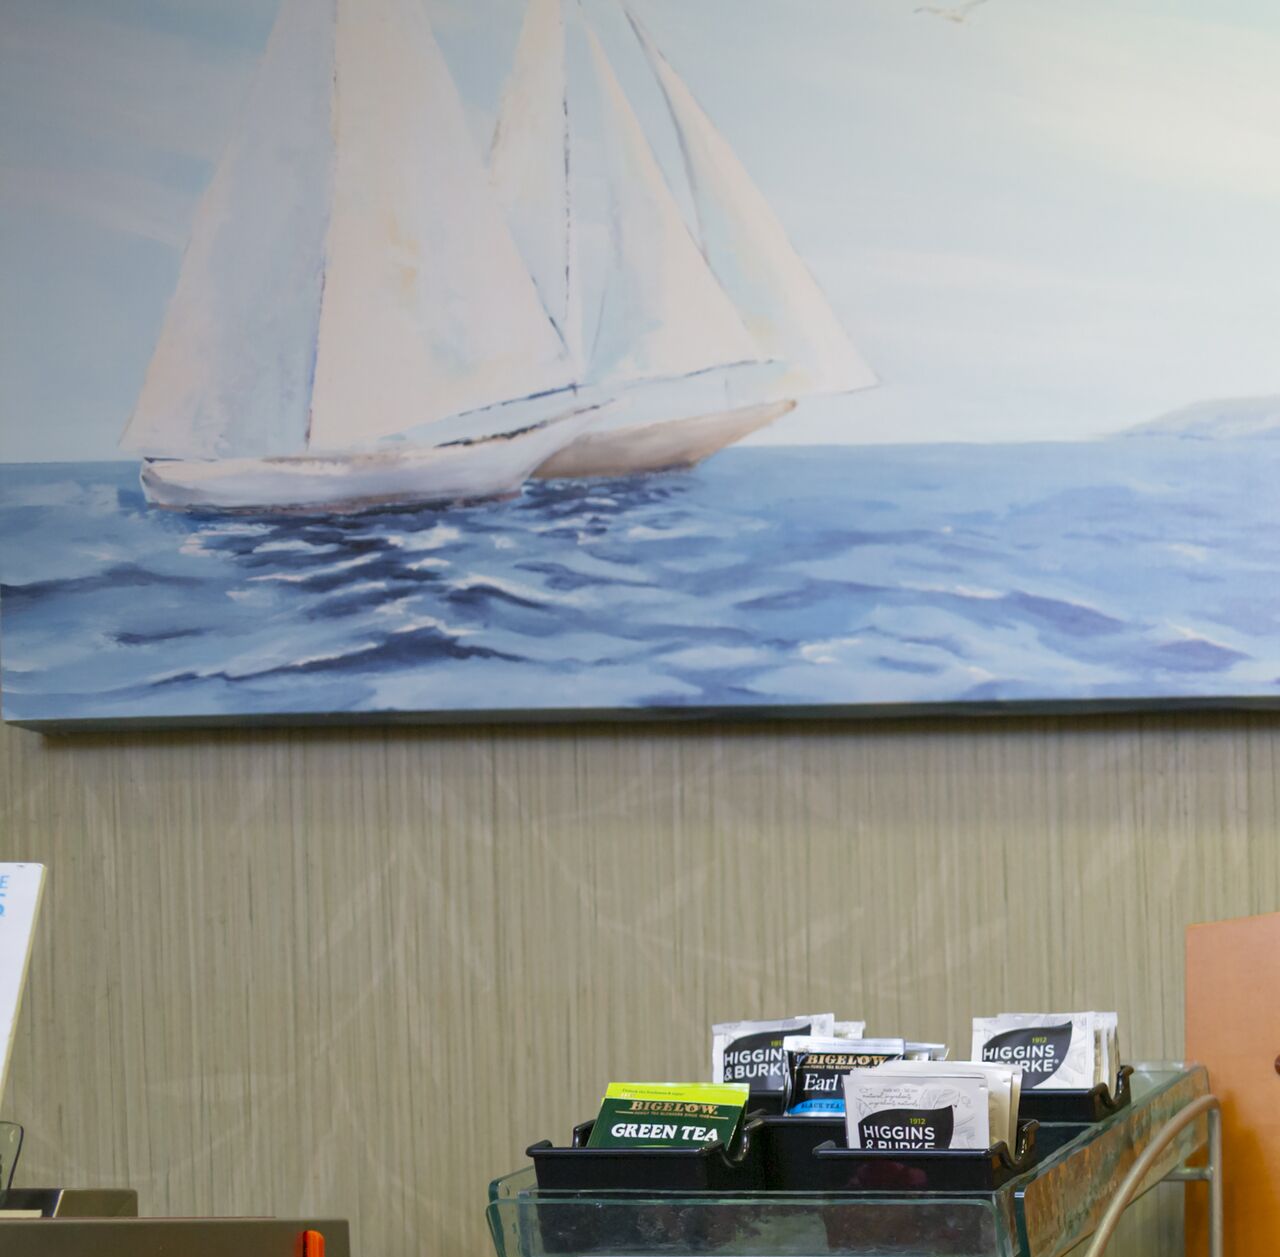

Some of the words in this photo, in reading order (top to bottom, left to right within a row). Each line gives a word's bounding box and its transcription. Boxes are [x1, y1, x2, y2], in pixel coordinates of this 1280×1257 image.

[724, 1047, 785, 1066] HIGGIN
[806, 1054, 888, 1066] BIGELOW
[983, 1044, 1055, 1061] HIGGINS
[734, 1063, 786, 1079] BURK
[803, 1072, 839, 1092] Earl
[630, 1100, 719, 1115] BIGELOW
[909, 1117, 927, 1125] 1912
[611, 1122, 676, 1140] GREEN
[680, 1125, 719, 1142] TEA
[863, 1125, 935, 1140] HIGGINS
